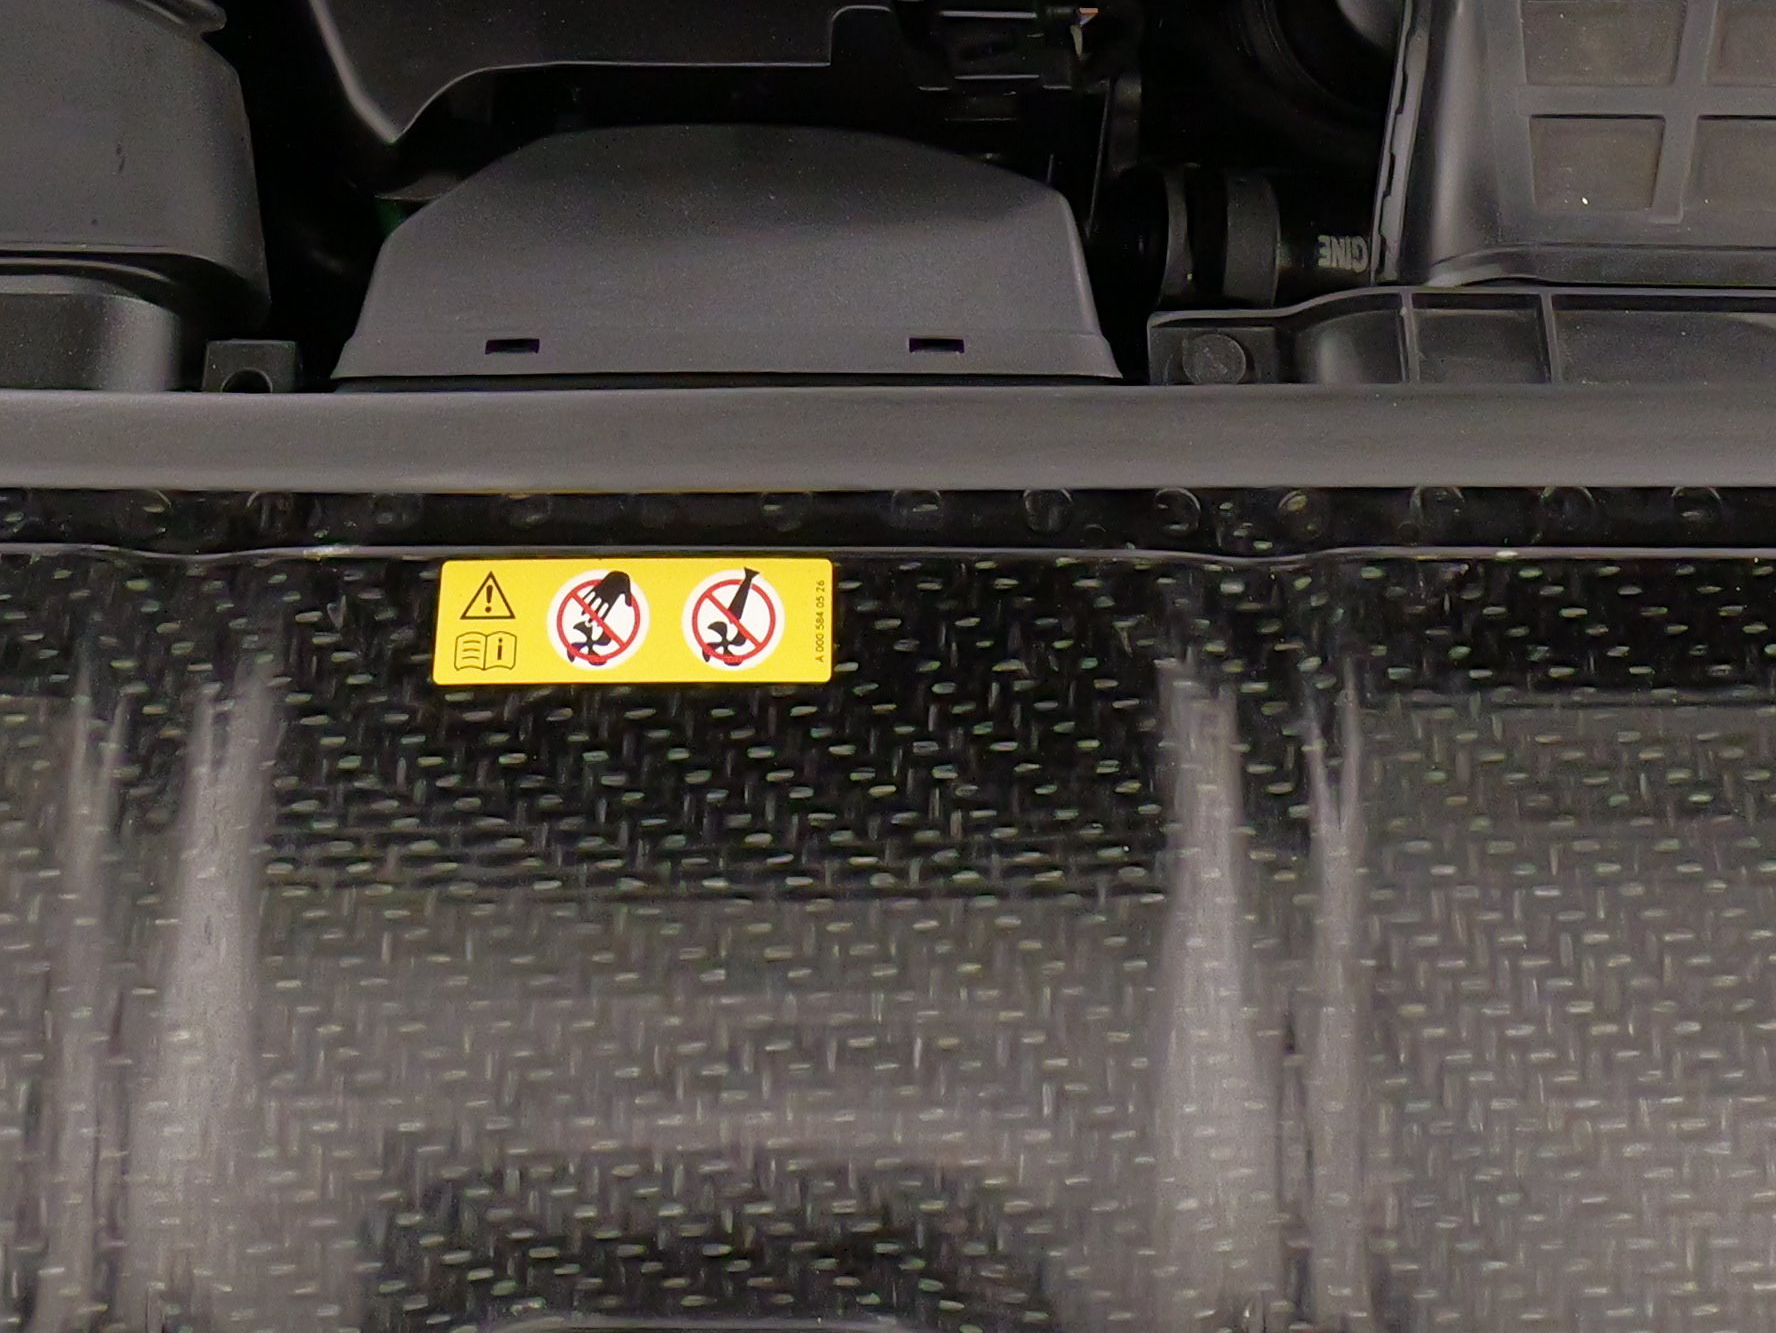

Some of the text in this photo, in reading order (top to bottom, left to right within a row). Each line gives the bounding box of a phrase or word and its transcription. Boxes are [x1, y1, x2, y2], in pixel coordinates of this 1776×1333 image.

[815, 579, 825, 663] A 000 584 05 26
